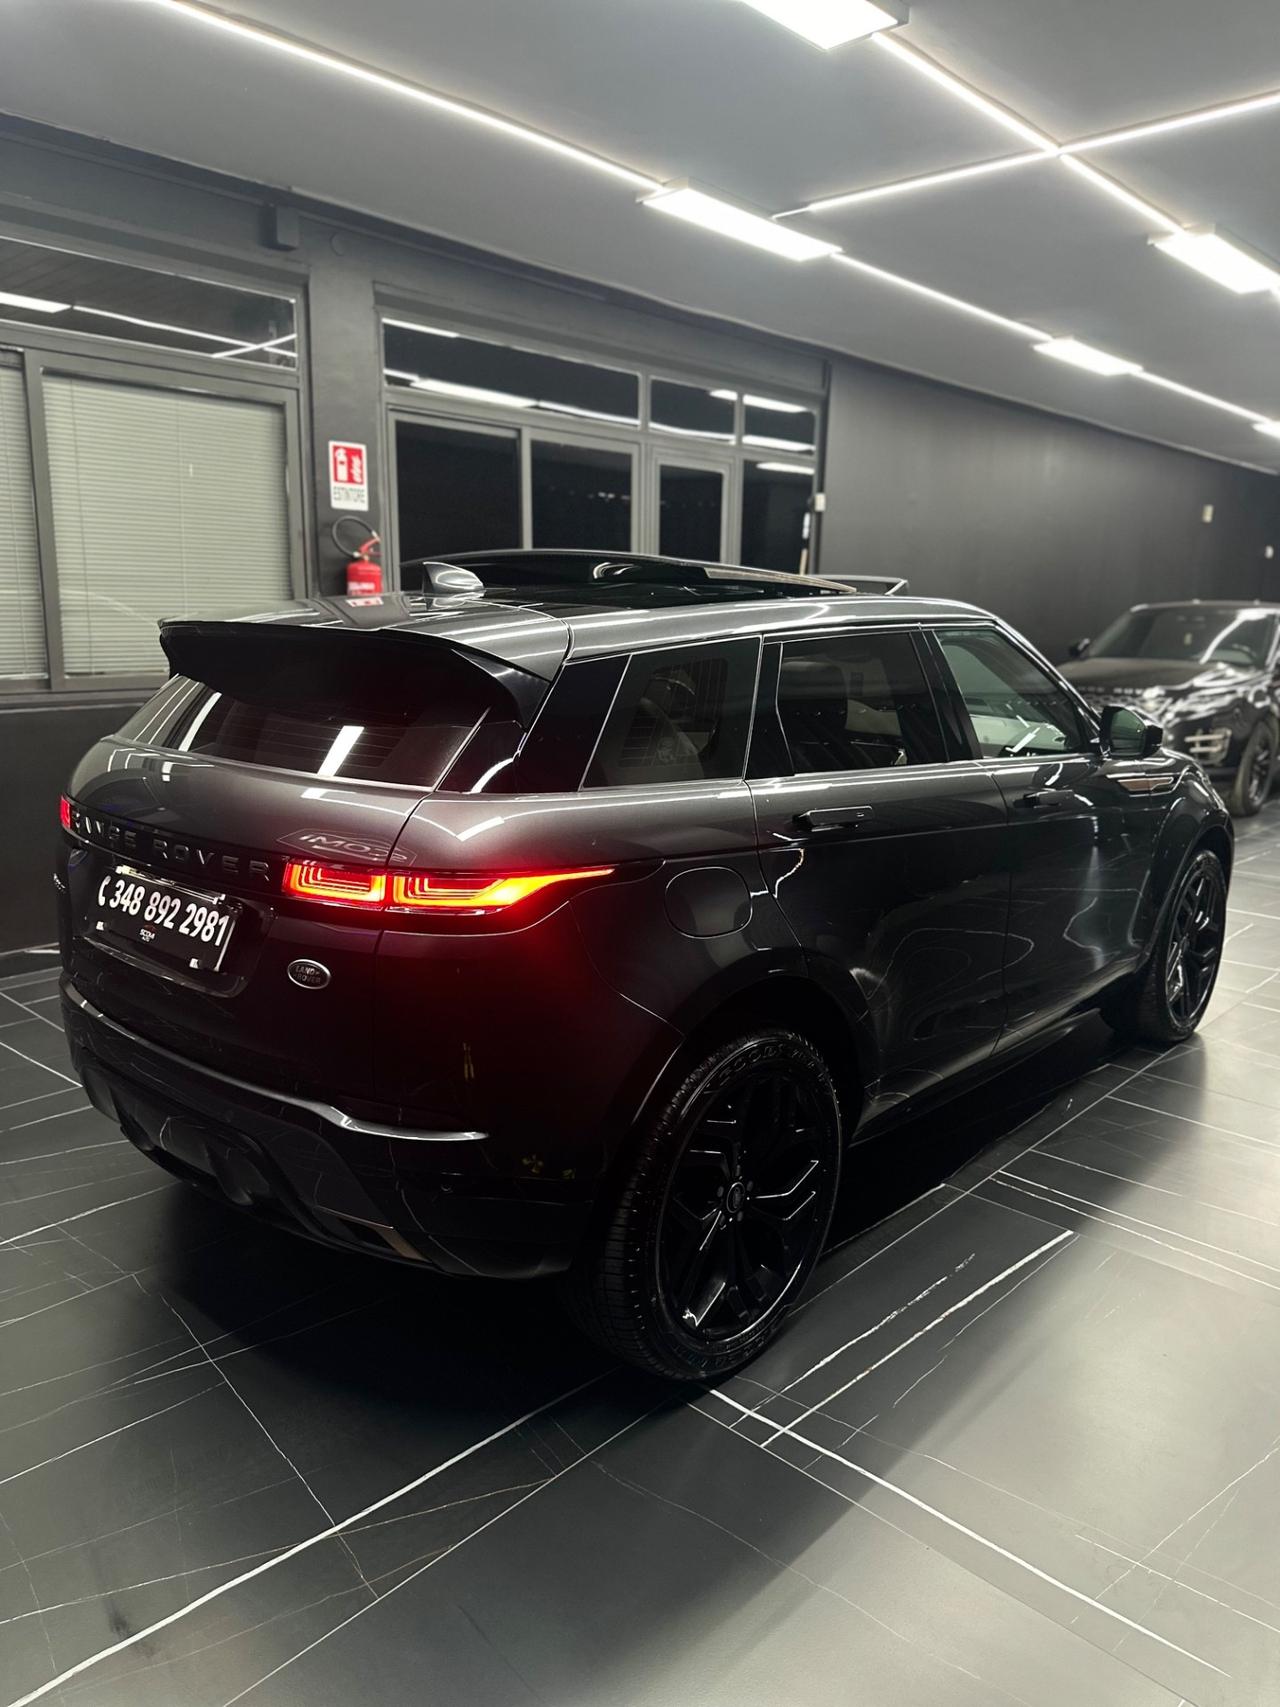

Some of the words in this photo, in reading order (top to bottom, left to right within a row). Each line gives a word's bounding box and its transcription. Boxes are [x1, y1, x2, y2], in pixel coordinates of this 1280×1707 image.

[152, 838, 271, 881] ROVER
[109, 877, 143, 916] 348
[144, 890, 181, 929] 892
[180, 902, 230, 947] 2981
[295, 965, 315, 976] LAND
[297, 973, 321, 984] ROVER
